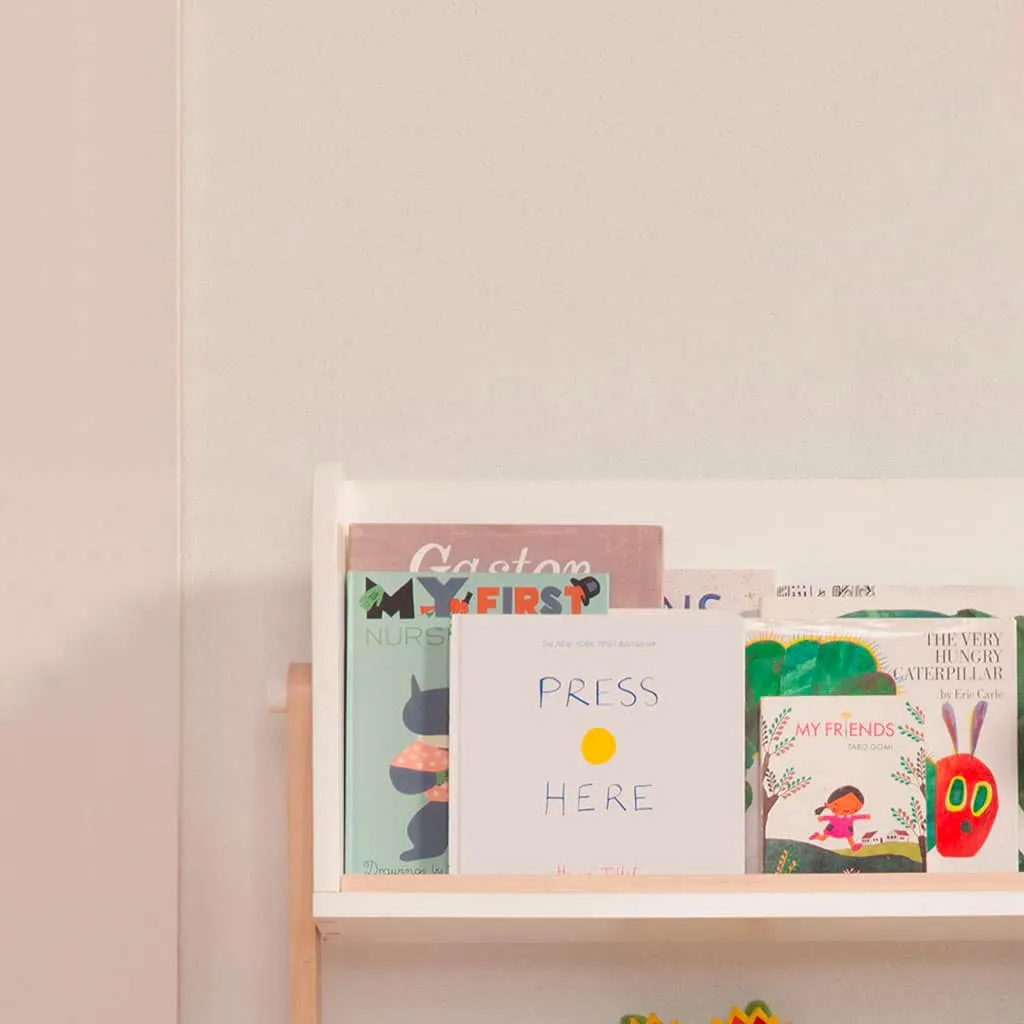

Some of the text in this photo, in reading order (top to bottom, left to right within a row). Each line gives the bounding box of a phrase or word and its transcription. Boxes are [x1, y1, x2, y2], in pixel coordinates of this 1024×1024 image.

[363, 576, 584, 619] MY FIRST
[365, 626, 452, 647] NURS
[924, 632, 1003, 647] THE VERY
[936, 649, 1003, 664] HUNGRY
[893, 666, 1004, 681] CATERPILLAR
[539, 676, 660, 708] PRESS
[940, 689, 1004, 700] by Eric Carle
[795, 720, 895, 738] MY FRIENDS
[545, 781, 654, 816] HERE
